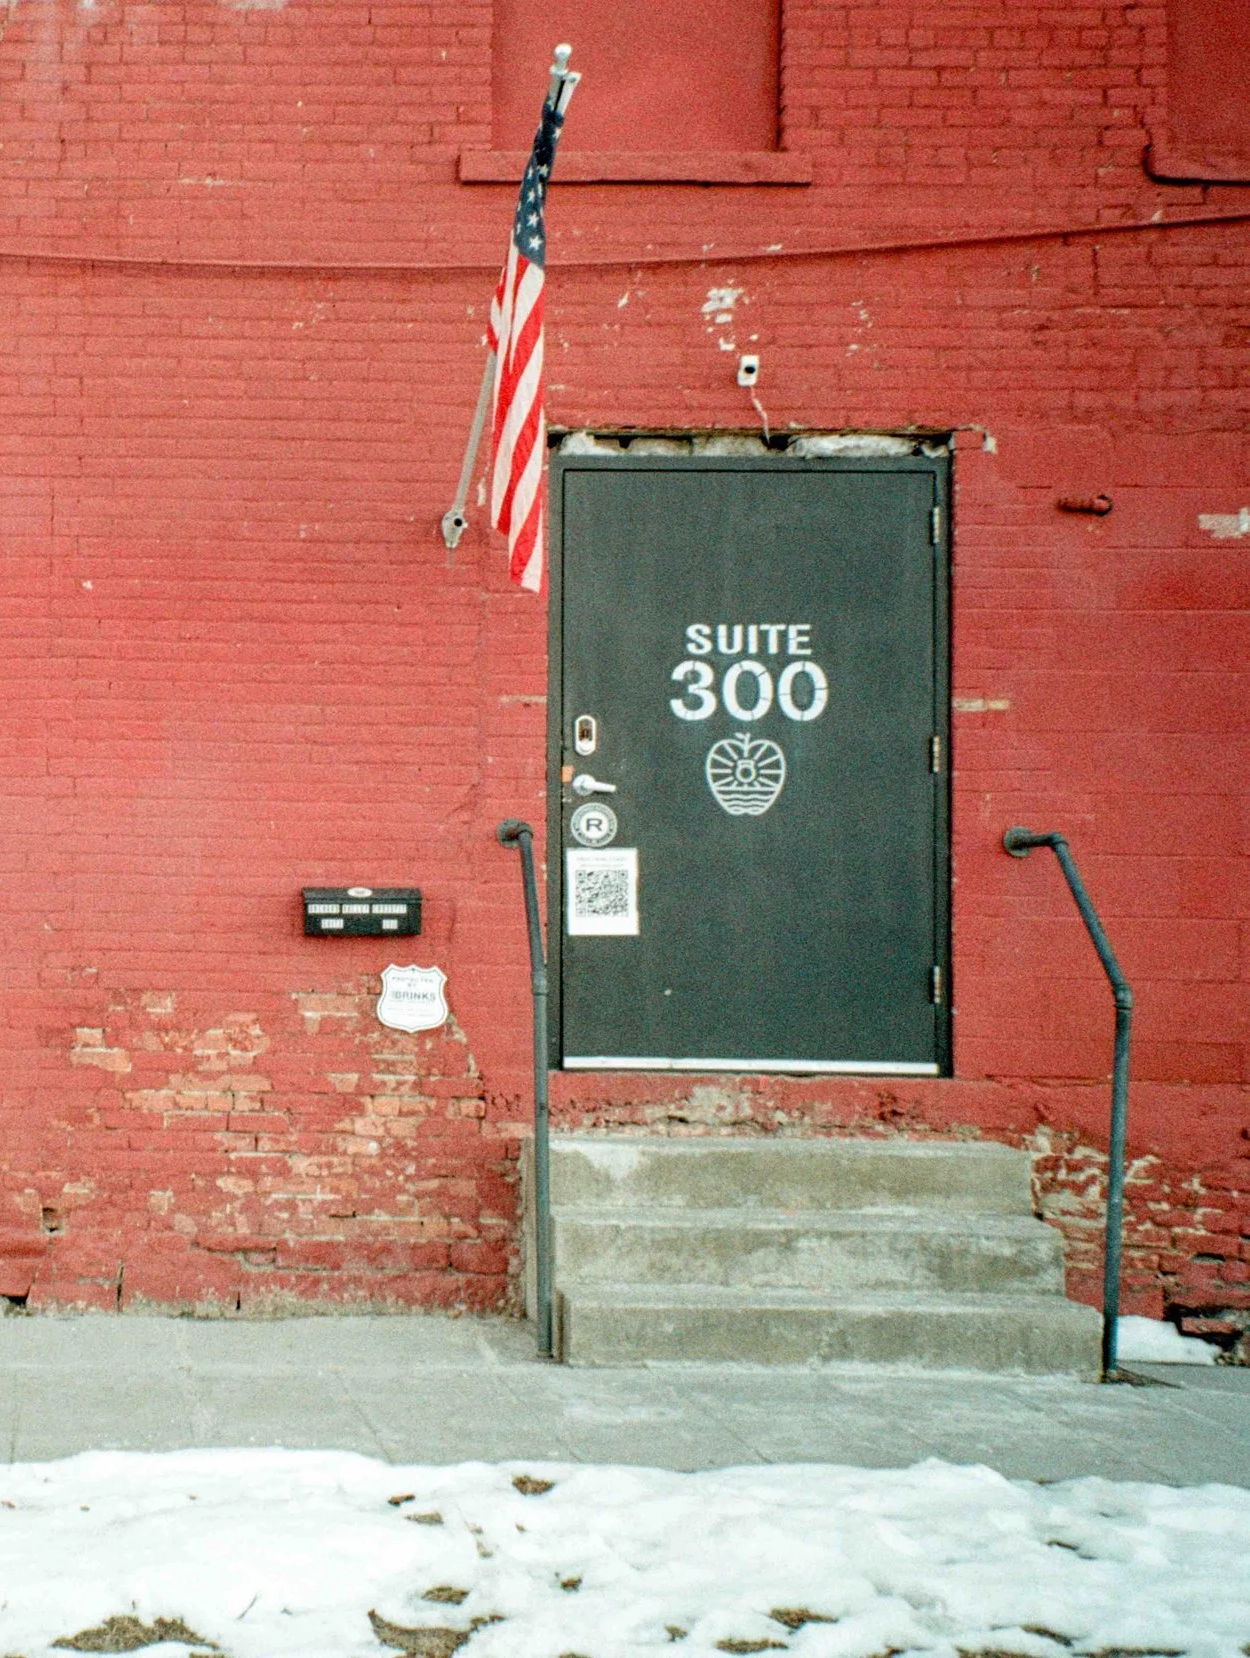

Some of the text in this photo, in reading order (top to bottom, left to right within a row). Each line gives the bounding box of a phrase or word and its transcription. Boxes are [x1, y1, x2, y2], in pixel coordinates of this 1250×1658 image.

[686, 624, 812, 655] SUITE
[670, 660, 828, 722] 300
[586, 818, 603, 832] R
